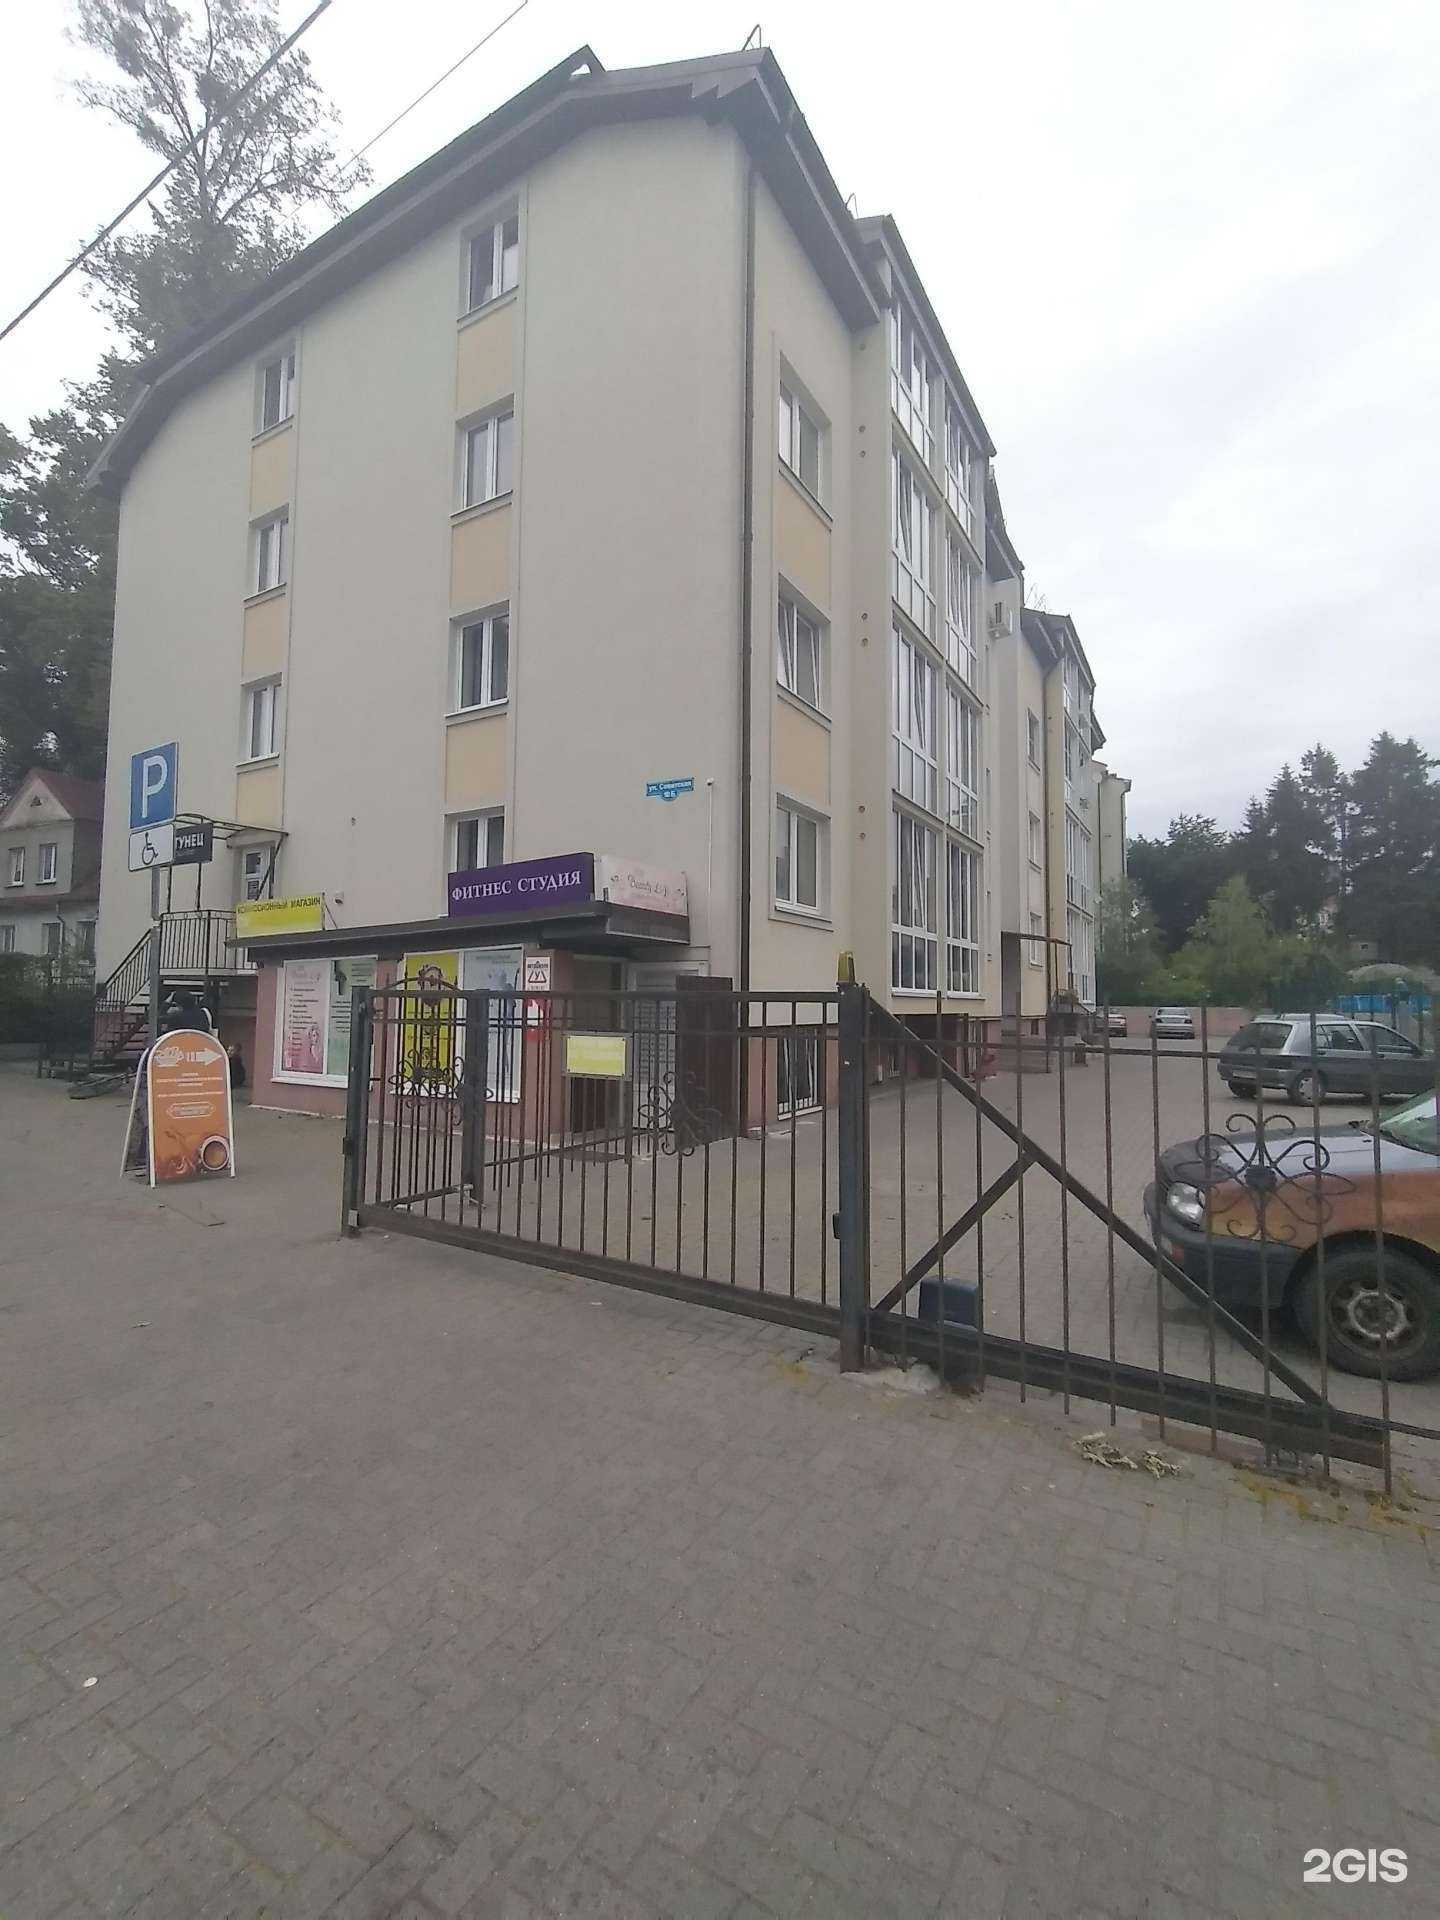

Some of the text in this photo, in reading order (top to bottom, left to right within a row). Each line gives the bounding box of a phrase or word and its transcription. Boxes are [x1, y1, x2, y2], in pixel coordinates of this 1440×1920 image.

[142, 755, 167, 818] P
[452, 870, 581, 900] ФИТНЕС СТУДИЯ
[290, 896, 321, 909] МАГАЗИН
